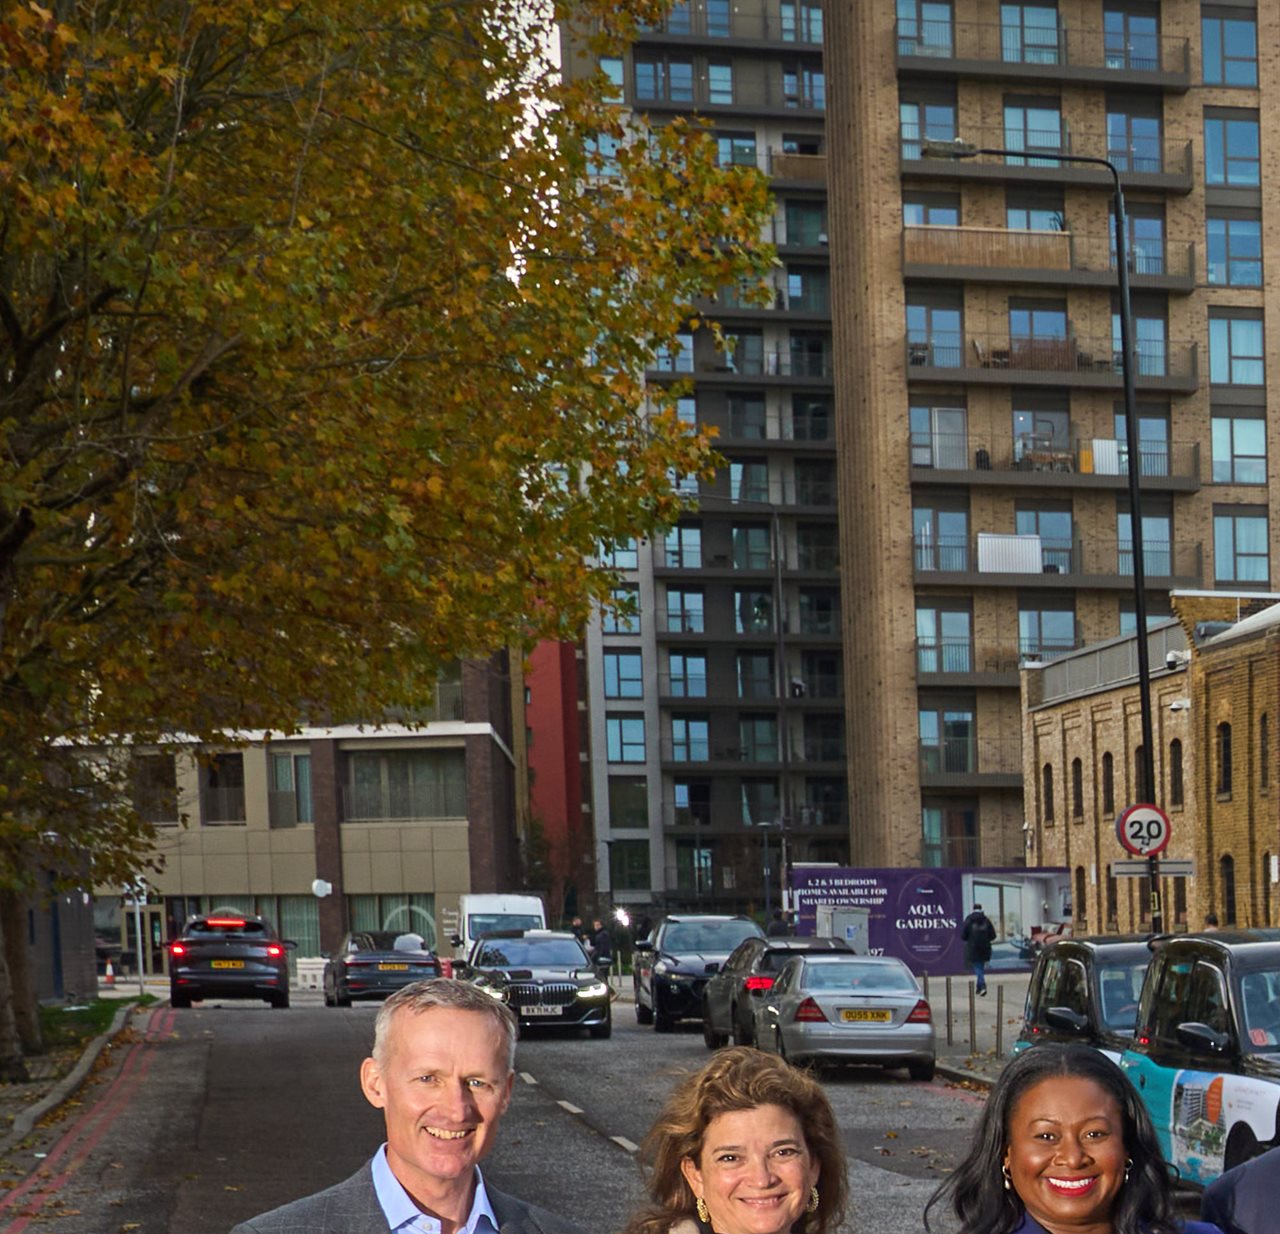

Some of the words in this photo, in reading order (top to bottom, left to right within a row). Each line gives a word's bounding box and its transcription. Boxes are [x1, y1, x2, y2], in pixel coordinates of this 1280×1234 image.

[1129, 820, 1162, 839] 20
[908, 905, 944, 915] AQUA
[896, 918, 957, 929] GARDENS
